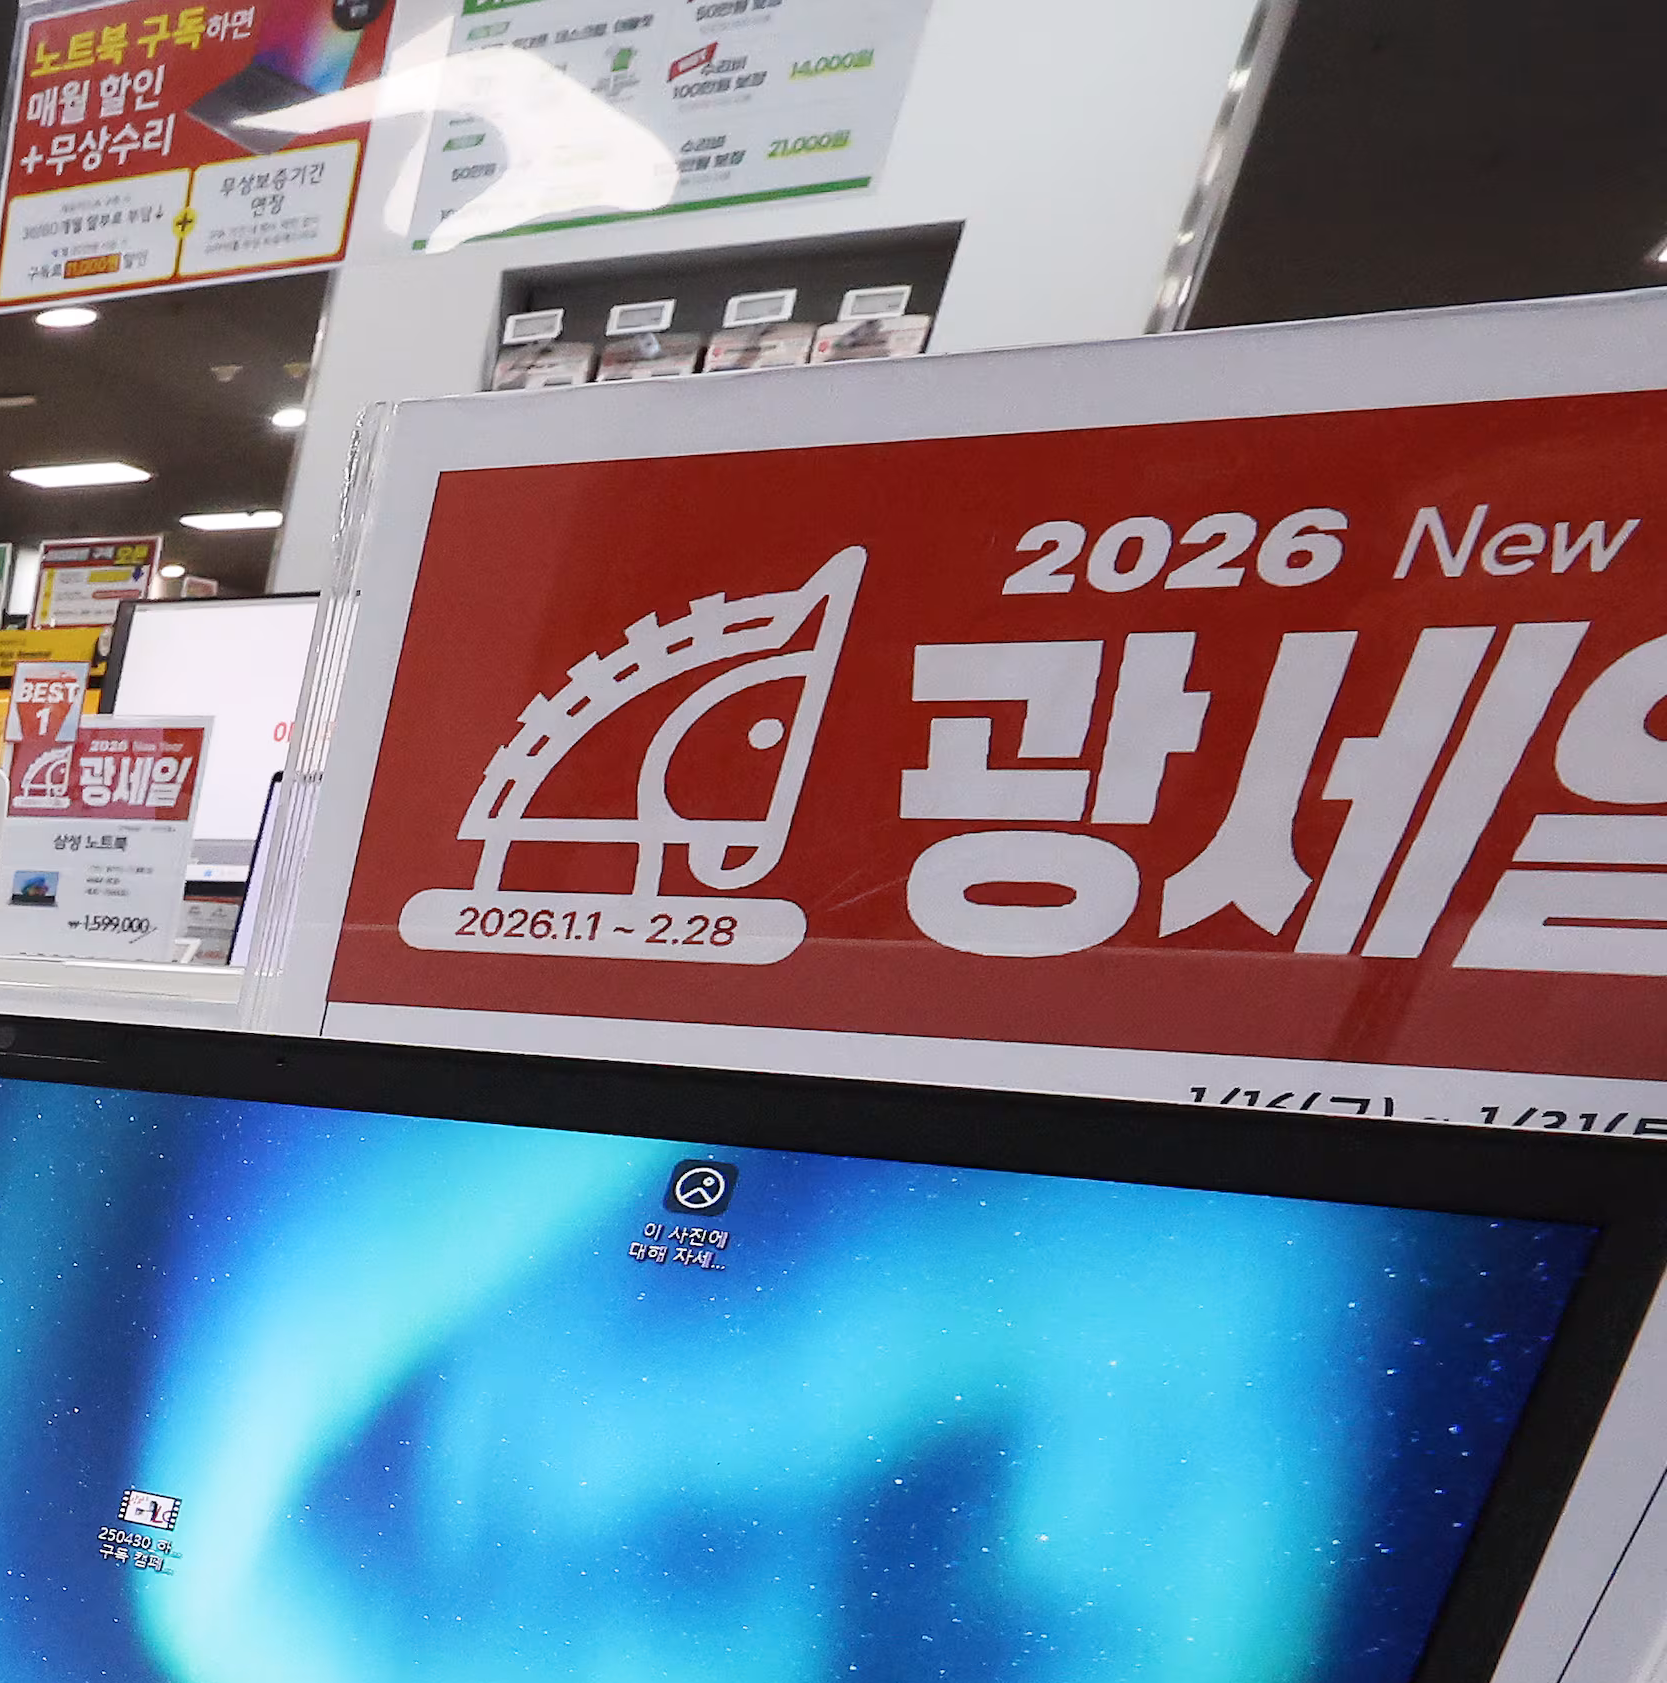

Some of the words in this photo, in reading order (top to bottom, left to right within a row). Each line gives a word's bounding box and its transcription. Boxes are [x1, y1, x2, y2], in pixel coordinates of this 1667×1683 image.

[31, 24, 128, 77] 노트북
[137, 6, 255, 59] 구독하면
[27, 78, 90, 127] 매월
[99, 64, 167, 118] 할인
[20, 115, 176, 176] +무상수리
[220, 162, 325, 198] 무상보증기간
[250, 195, 284, 218] 연장
[1002, 506, 1350, 596] 2026
[1392, 502, 1640, 580] New
[17, 681, 80, 704] BEST
[35, 707, 51, 736] 1
[78, 756, 194, 808] 광세일
[53, 834, 82, 851] 삼성
[456, 905, 600, 945] 2026.1.1
[644, 911, 738, 949] 2.28
[643, 1222, 664, 1241] 이
[667, 1225, 729, 1250] 사진에
[628, 1241, 668, 1264] 대해
[99, 1543, 130, 1563] 구독
